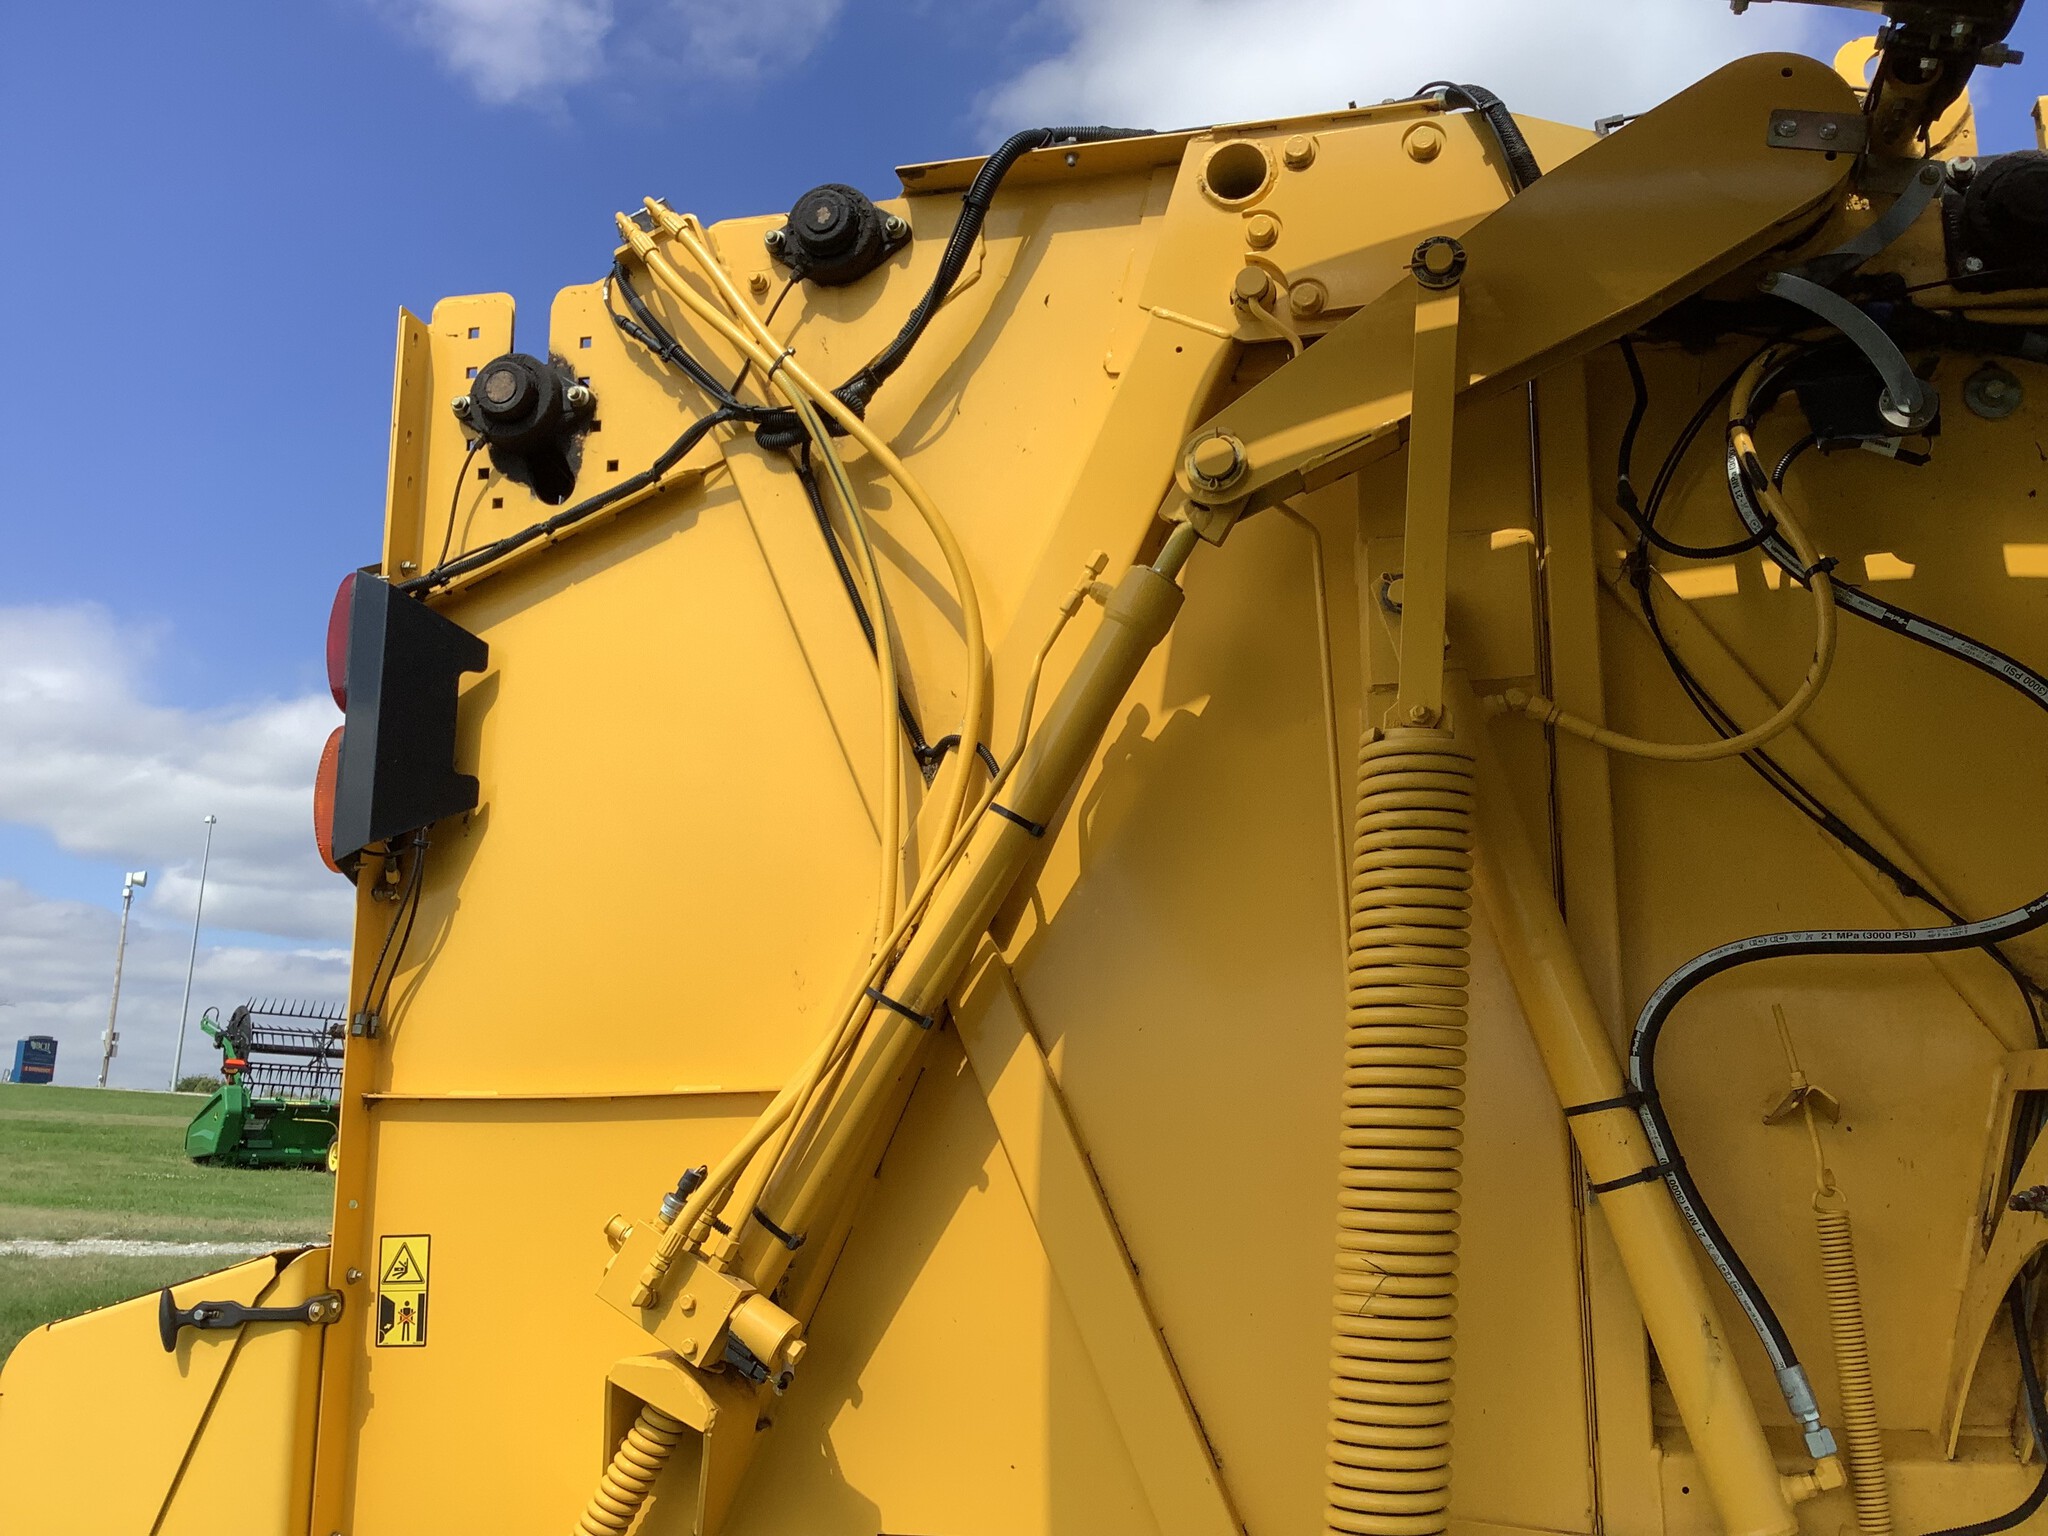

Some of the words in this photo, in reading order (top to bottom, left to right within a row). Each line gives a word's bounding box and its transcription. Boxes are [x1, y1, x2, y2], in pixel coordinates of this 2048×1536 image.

[1734, 490, 1744, 500] 21
[2003, 663, 2024, 680] PSI)
[2022, 676, 2048, 697] (3000
[1820, 932, 1833, 940] 21
[1836, 932, 1860, 940] MPa
[1862, 931, 1892, 940] (3000
[1894, 931, 1917, 940] PSI)
[1669, 1179, 1686, 1205] (3000
[1683, 1205, 1699, 1227] MPa
[1695, 1228, 1707, 1239] 21
